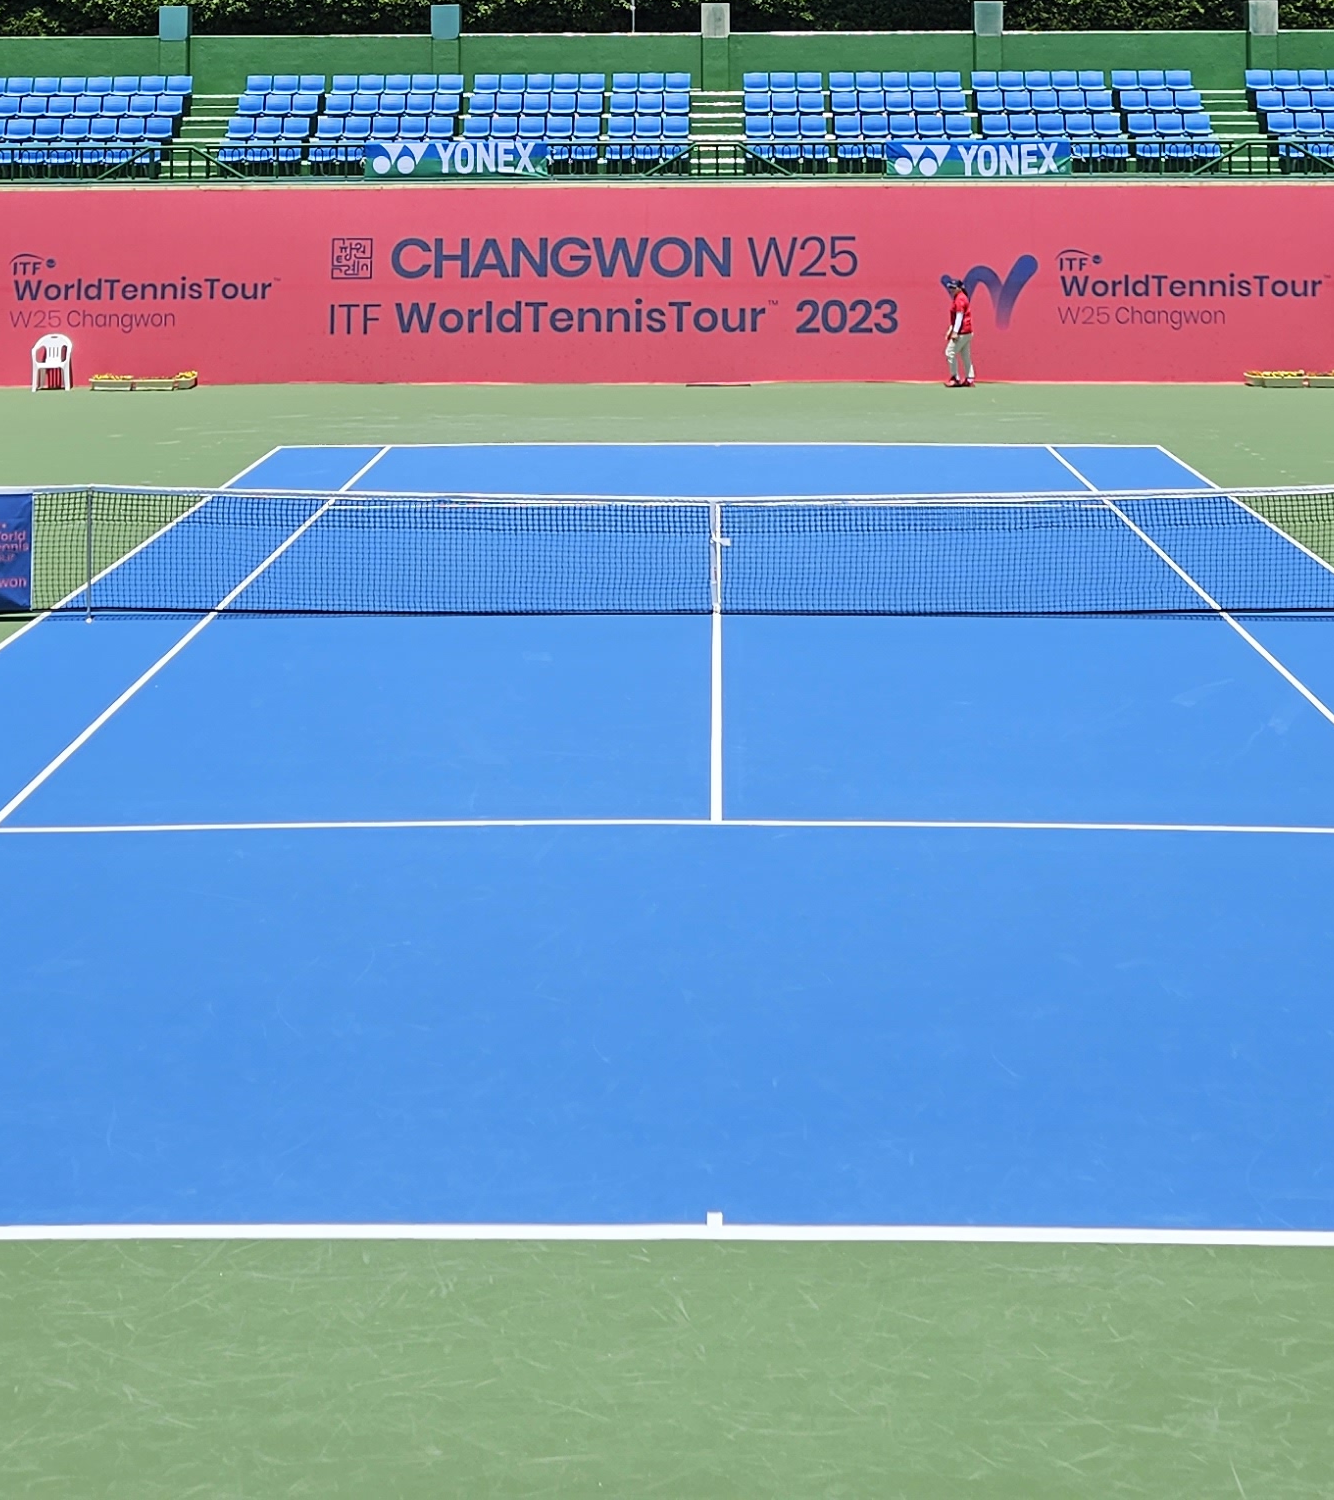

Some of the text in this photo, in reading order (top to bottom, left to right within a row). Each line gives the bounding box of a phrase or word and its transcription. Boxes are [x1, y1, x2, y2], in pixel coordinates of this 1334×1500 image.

[435, 141, 535, 174] YONEX
[958, 142, 1059, 176] YONEX
[12, 261, 42, 276] ITF
[391, 235, 858, 279] CHANGWON W25
[1058, 257, 1088, 271] ITF
[9, 309, 176, 333] W25 Changwon
[329, 303, 382, 335] ITF
[796, 299, 898, 334] 2023
[1057, 305, 1225, 330] W25 Changwon
